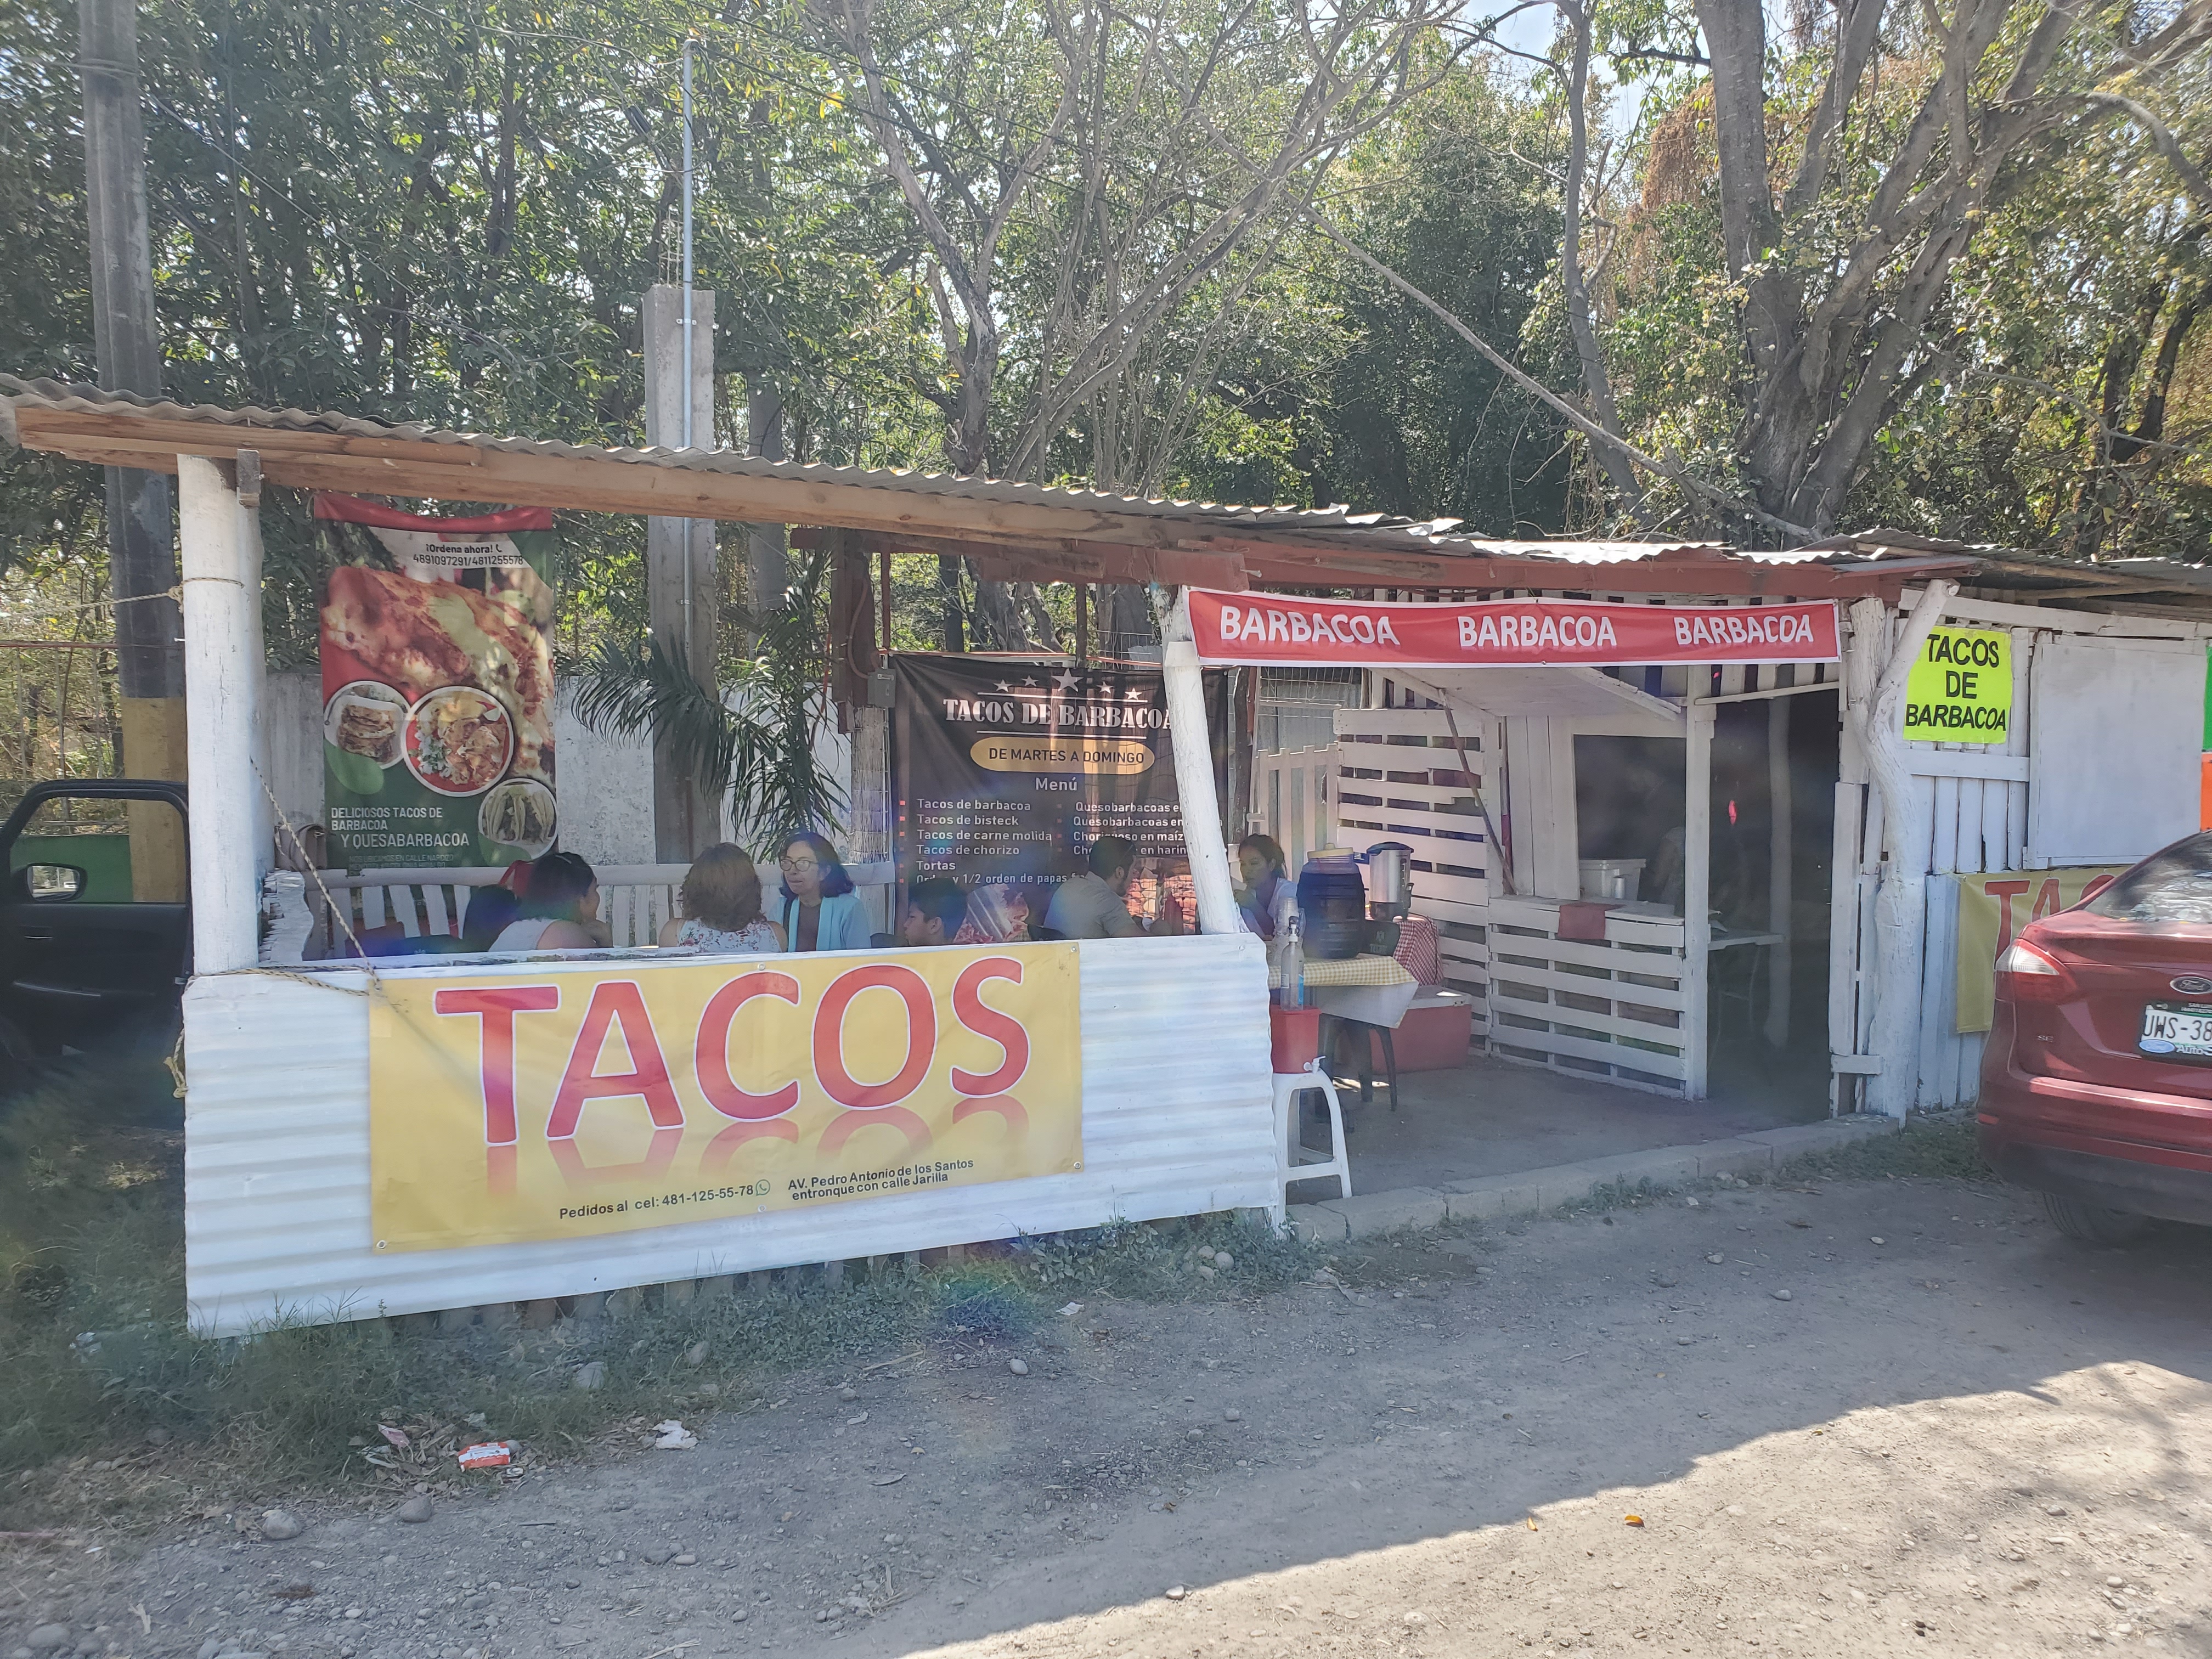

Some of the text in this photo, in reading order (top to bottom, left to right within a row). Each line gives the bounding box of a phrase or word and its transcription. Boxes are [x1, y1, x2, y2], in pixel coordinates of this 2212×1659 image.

[426, 544, 493, 554] ¡Ordena ahora!
[1221, 606, 1400, 646] BARBACOA
[1458, 615, 1617, 647] BARBACOA
[1674, 614, 1813, 645] BARBACOA
[1927, 634, 1999, 668] TACOS
[1945, 670, 1978, 699] DE
[943, 699, 1013, 724] TACOS
[1022, 702, 1052, 725] DE
[1905, 703, 2006, 731] BARBACOA
[989, 748, 1144, 763] DE MARTES A DOMINGO
[1036, 776, 1077, 791] Menú
[917, 798, 1031, 811] Tacos de barbacoa
[1075, 802, 1171, 812] Quesobarbacoas
[331, 808, 443, 818] DELICIOSOS TACOS DE
[917, 814, 1019, 826] Tacos de bisteck
[331, 820, 388, 831] BARBACOA
[1073, 816, 1168, 827] Quesobarbacoas
[341, 833, 470, 849] Y QUESABARBACOA
[917, 829, 1052, 841] Tacos de carne molida
[1157, 830, 1184, 841] maíz
[916, 844, 1020, 855] Tacos de chorizo
[916, 860, 956, 871] Tortas
[963, 874, 981, 884] 1/2
[985, 873, 1016, 883] orden
[1020, 873, 1033, 883] de
[1037, 875, 1067, 885] papas
[433, 957, 1030, 1146] TACOS
[788, 1159, 974, 1191] AV. Pedro Antonio de los Santos
[792, 1172, 949, 1201] entronque con calle Jarilla
[560, 1184, 754, 1220] Pedidos al cel: 481-125-55-78
